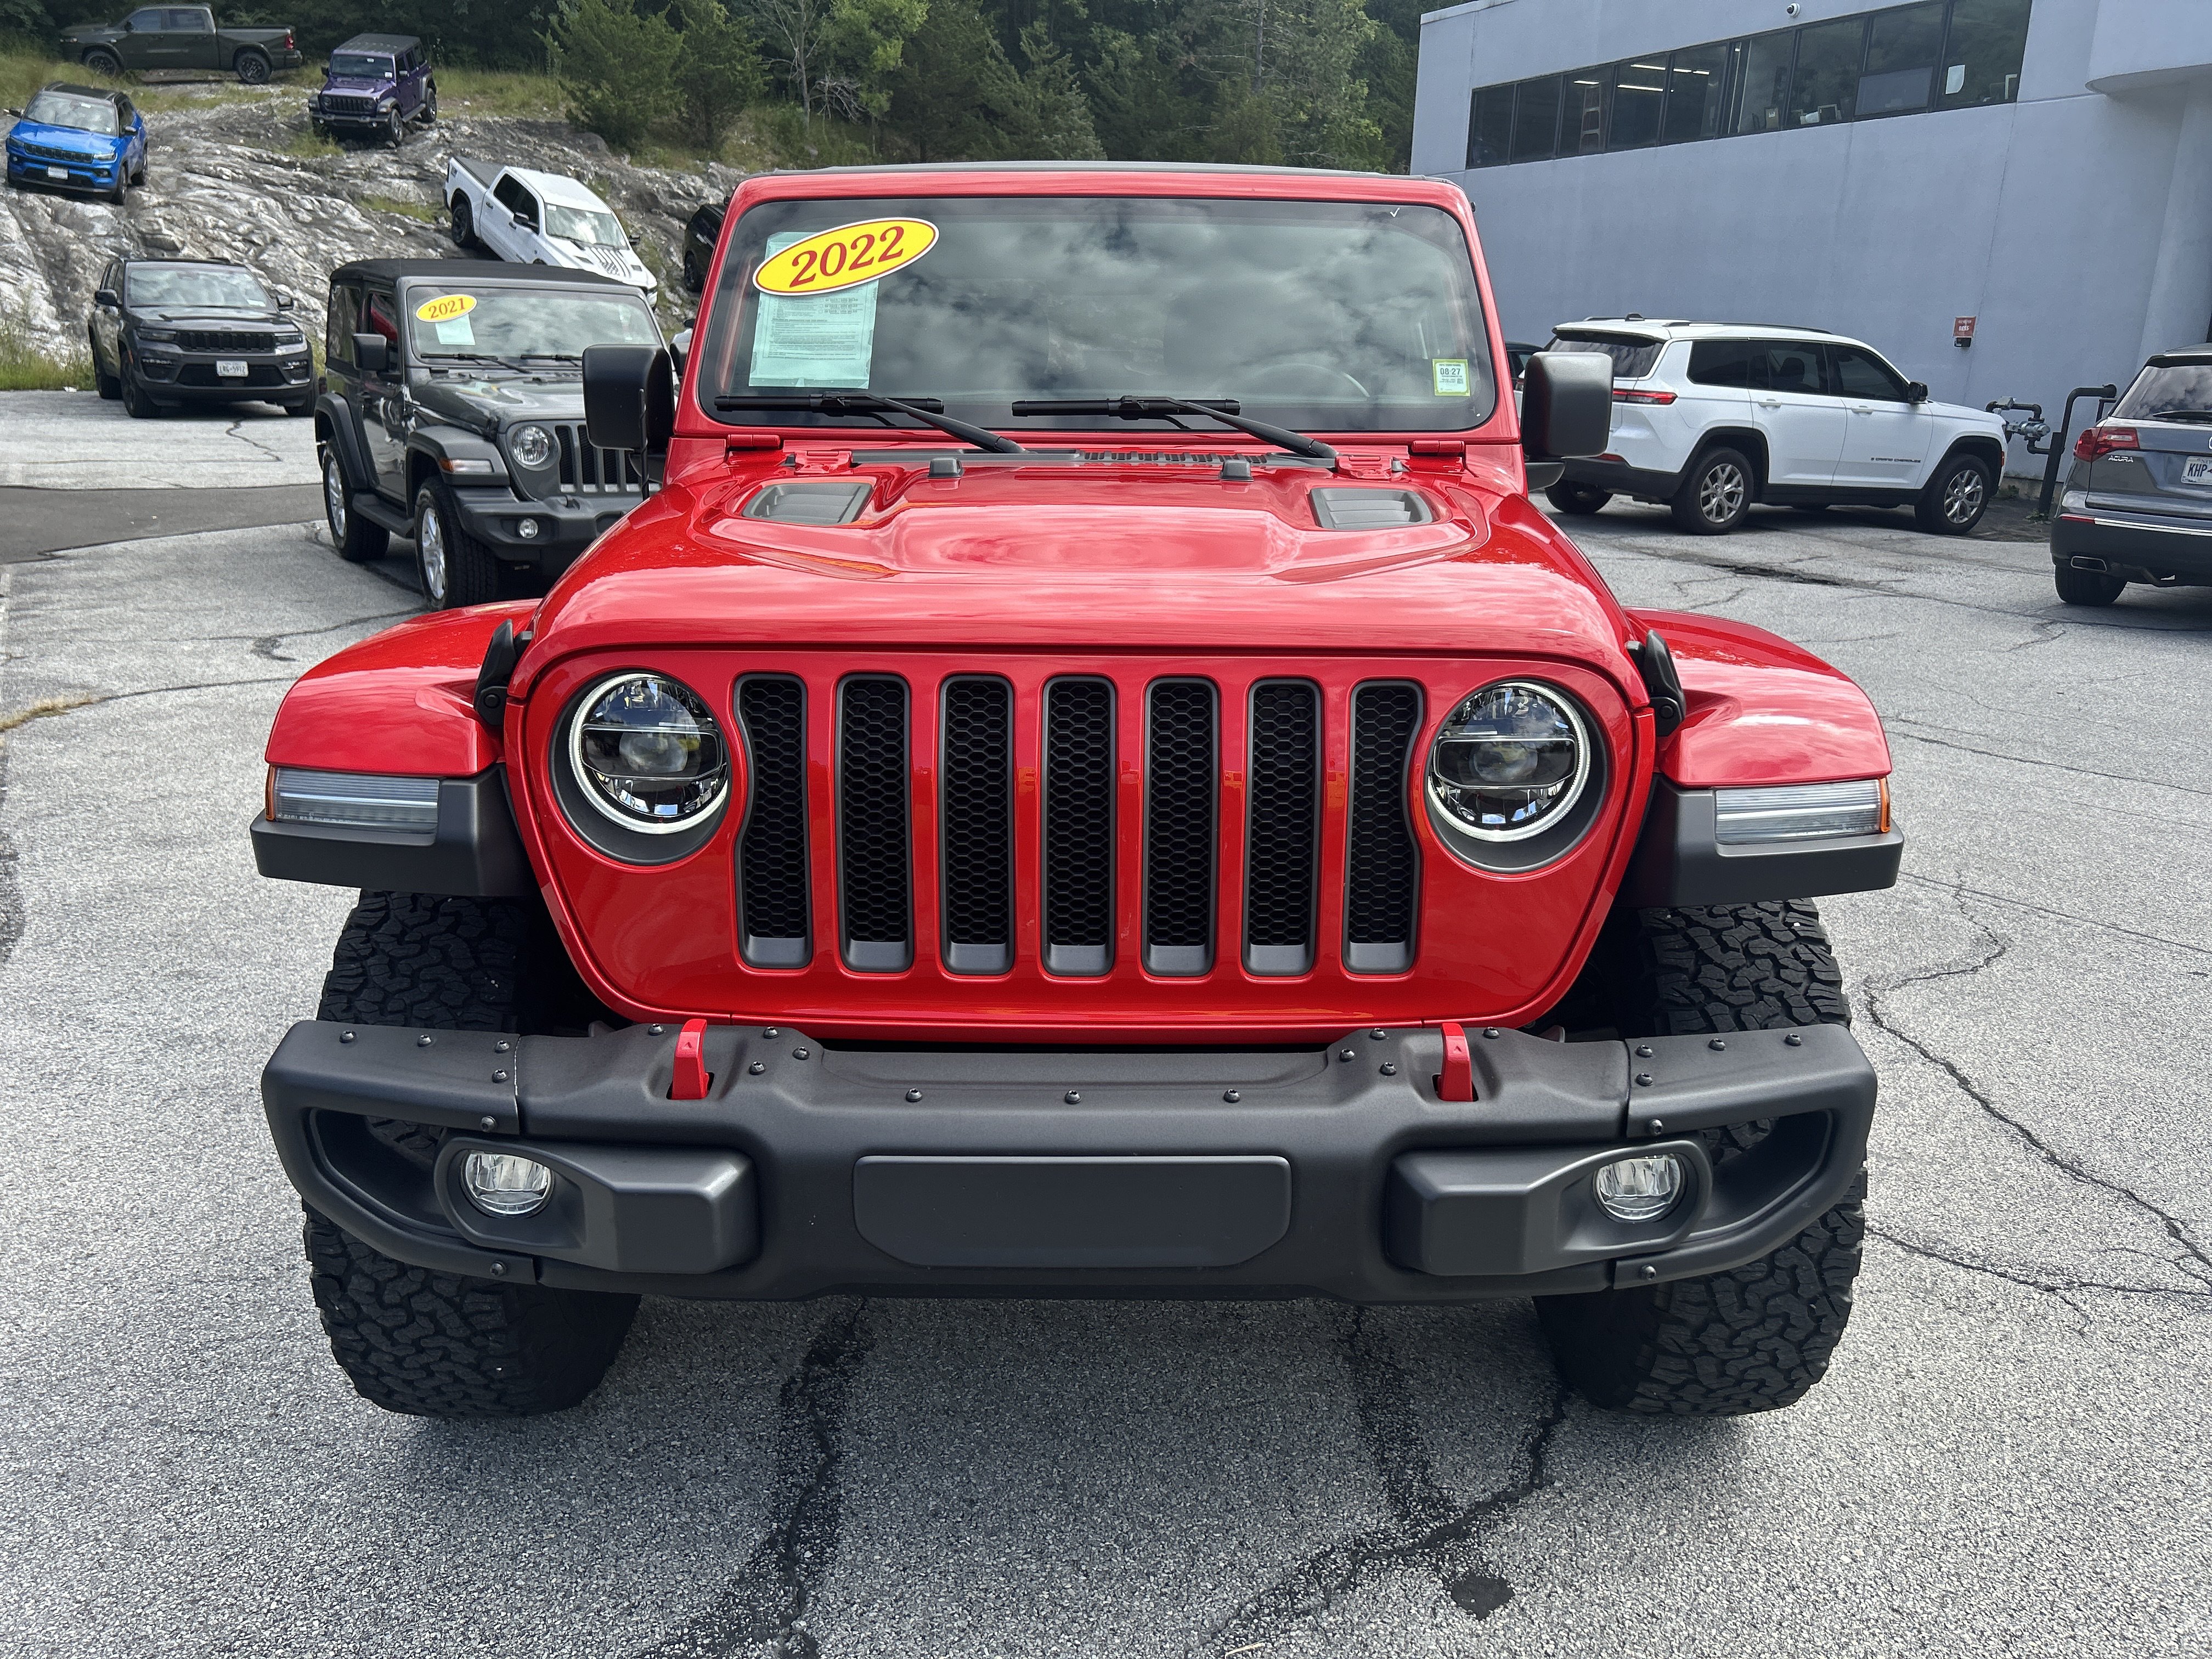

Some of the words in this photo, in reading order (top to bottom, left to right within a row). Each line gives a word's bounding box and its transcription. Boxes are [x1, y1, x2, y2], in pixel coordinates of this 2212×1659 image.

[789, 226, 904, 288] 2022
[428, 298, 465, 319] 2021
[2187, 463, 2208, 477] KHP
